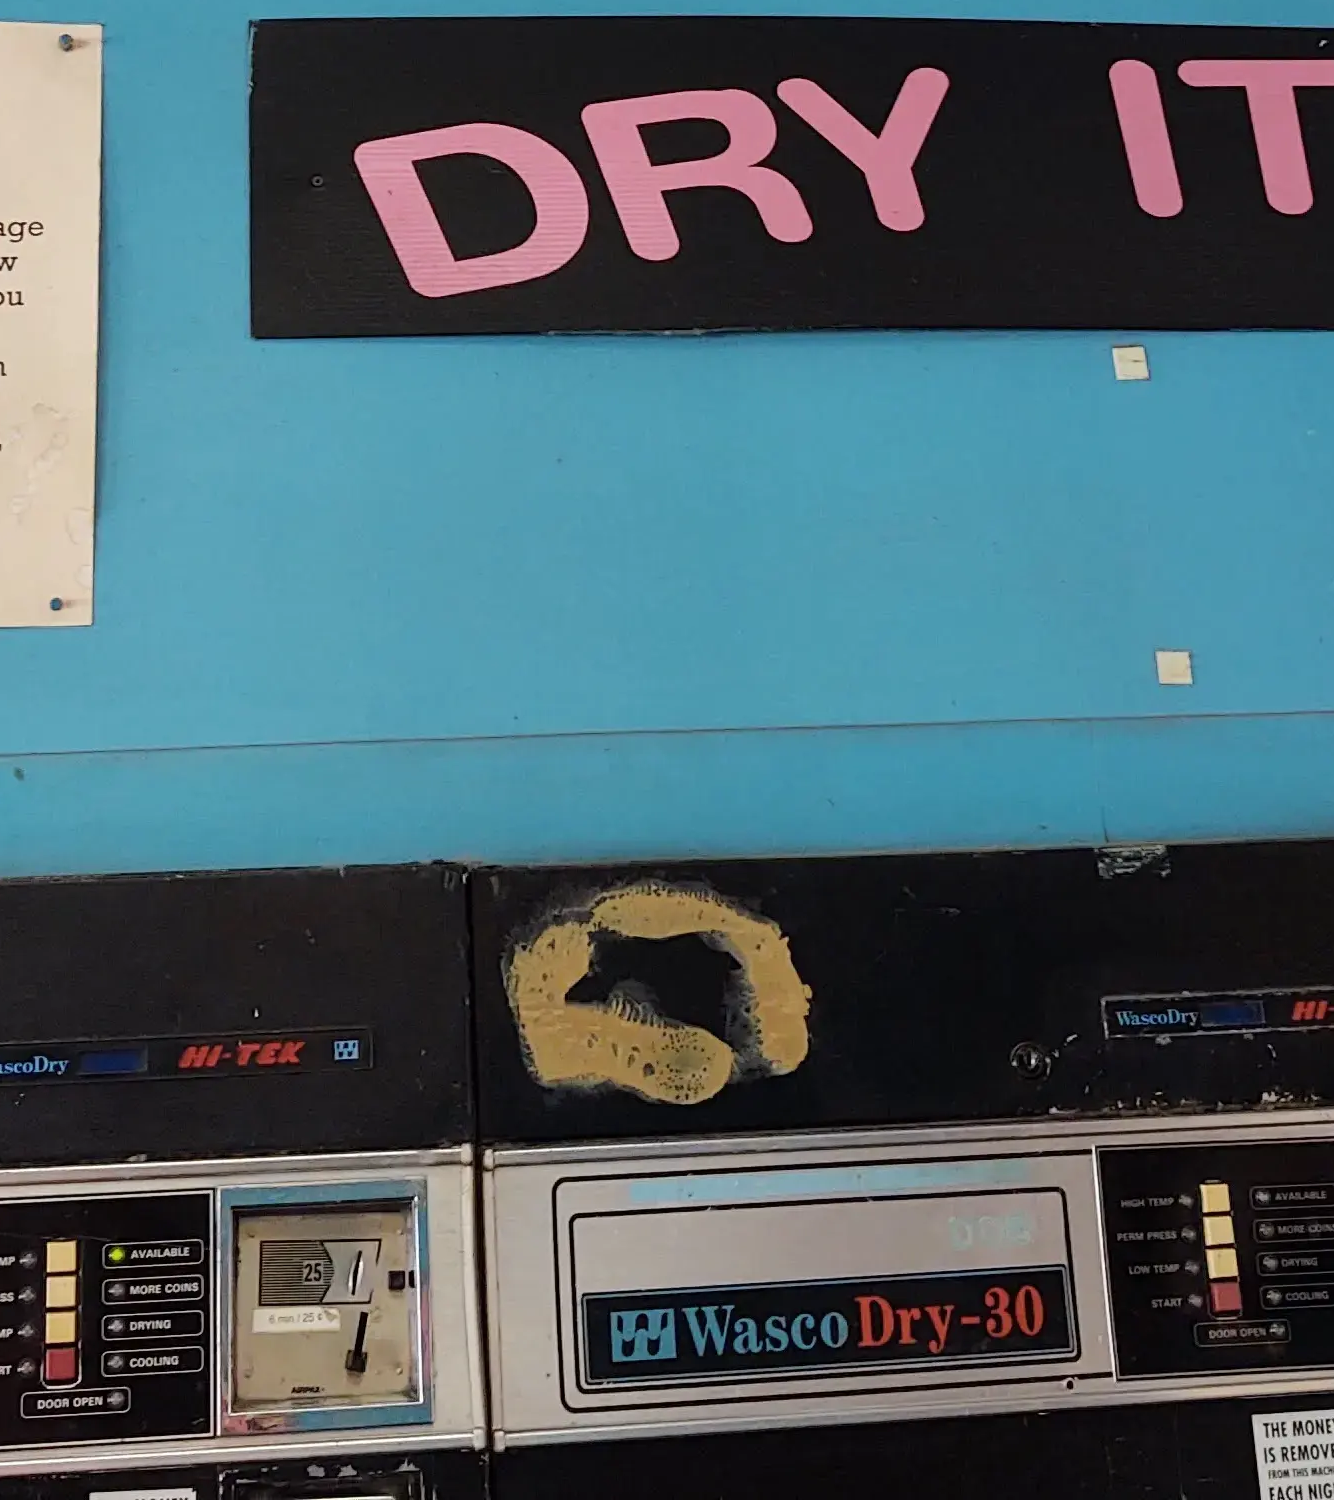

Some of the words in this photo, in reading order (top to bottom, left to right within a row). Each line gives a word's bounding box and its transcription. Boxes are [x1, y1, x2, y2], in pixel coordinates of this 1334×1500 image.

[355, 69, 948, 297] DRY
[1116, 1008, 1199, 1028] WascoDry
[178, 1040, 305, 1069] HI-TEK
[1275, 1191, 1327, 1201] AVAILABLE
[1121, 1199, 1145, 1208] HIGH
[1148, 1197, 1174, 1207] TEMP
[1277, 1225, 1305, 1234] MORE
[1117, 1232, 1144, 1242] PERM
[1147, 1230, 1177, 1240] PRESS
[131, 1247, 190, 1259] AVAILABLE
[1282, 1258, 1318, 1267] DRYING
[304, 1262, 322, 1282] 25
[1129, 1265, 1150, 1275] LOW
[1153, 1263, 1179, 1273] TEMP
[130, 1284, 161, 1295] MORE
[164, 1283, 199, 1293] COINS
[1286, 1291, 1329, 1301] COOLING
[1151, 1297, 1182, 1308] START
[130, 1320, 171, 1331] DRYING
[1209, 1329, 1237, 1340] DOOR
[1240, 1328, 1266, 1337] OPEN
[130, 1357, 179, 1368] COOLING
[37, 1398, 69, 1410] DOOR
[73, 1396, 103, 1408] OPEN
[1263, 1422, 1287, 1438] THE
[1264, 1447, 1275, 1463] IS
[1268, 1469, 1289, 1479] FROM
[1293, 1468, 1309, 1477] THIS
[1269, 1485, 1303, 1500] EACH
